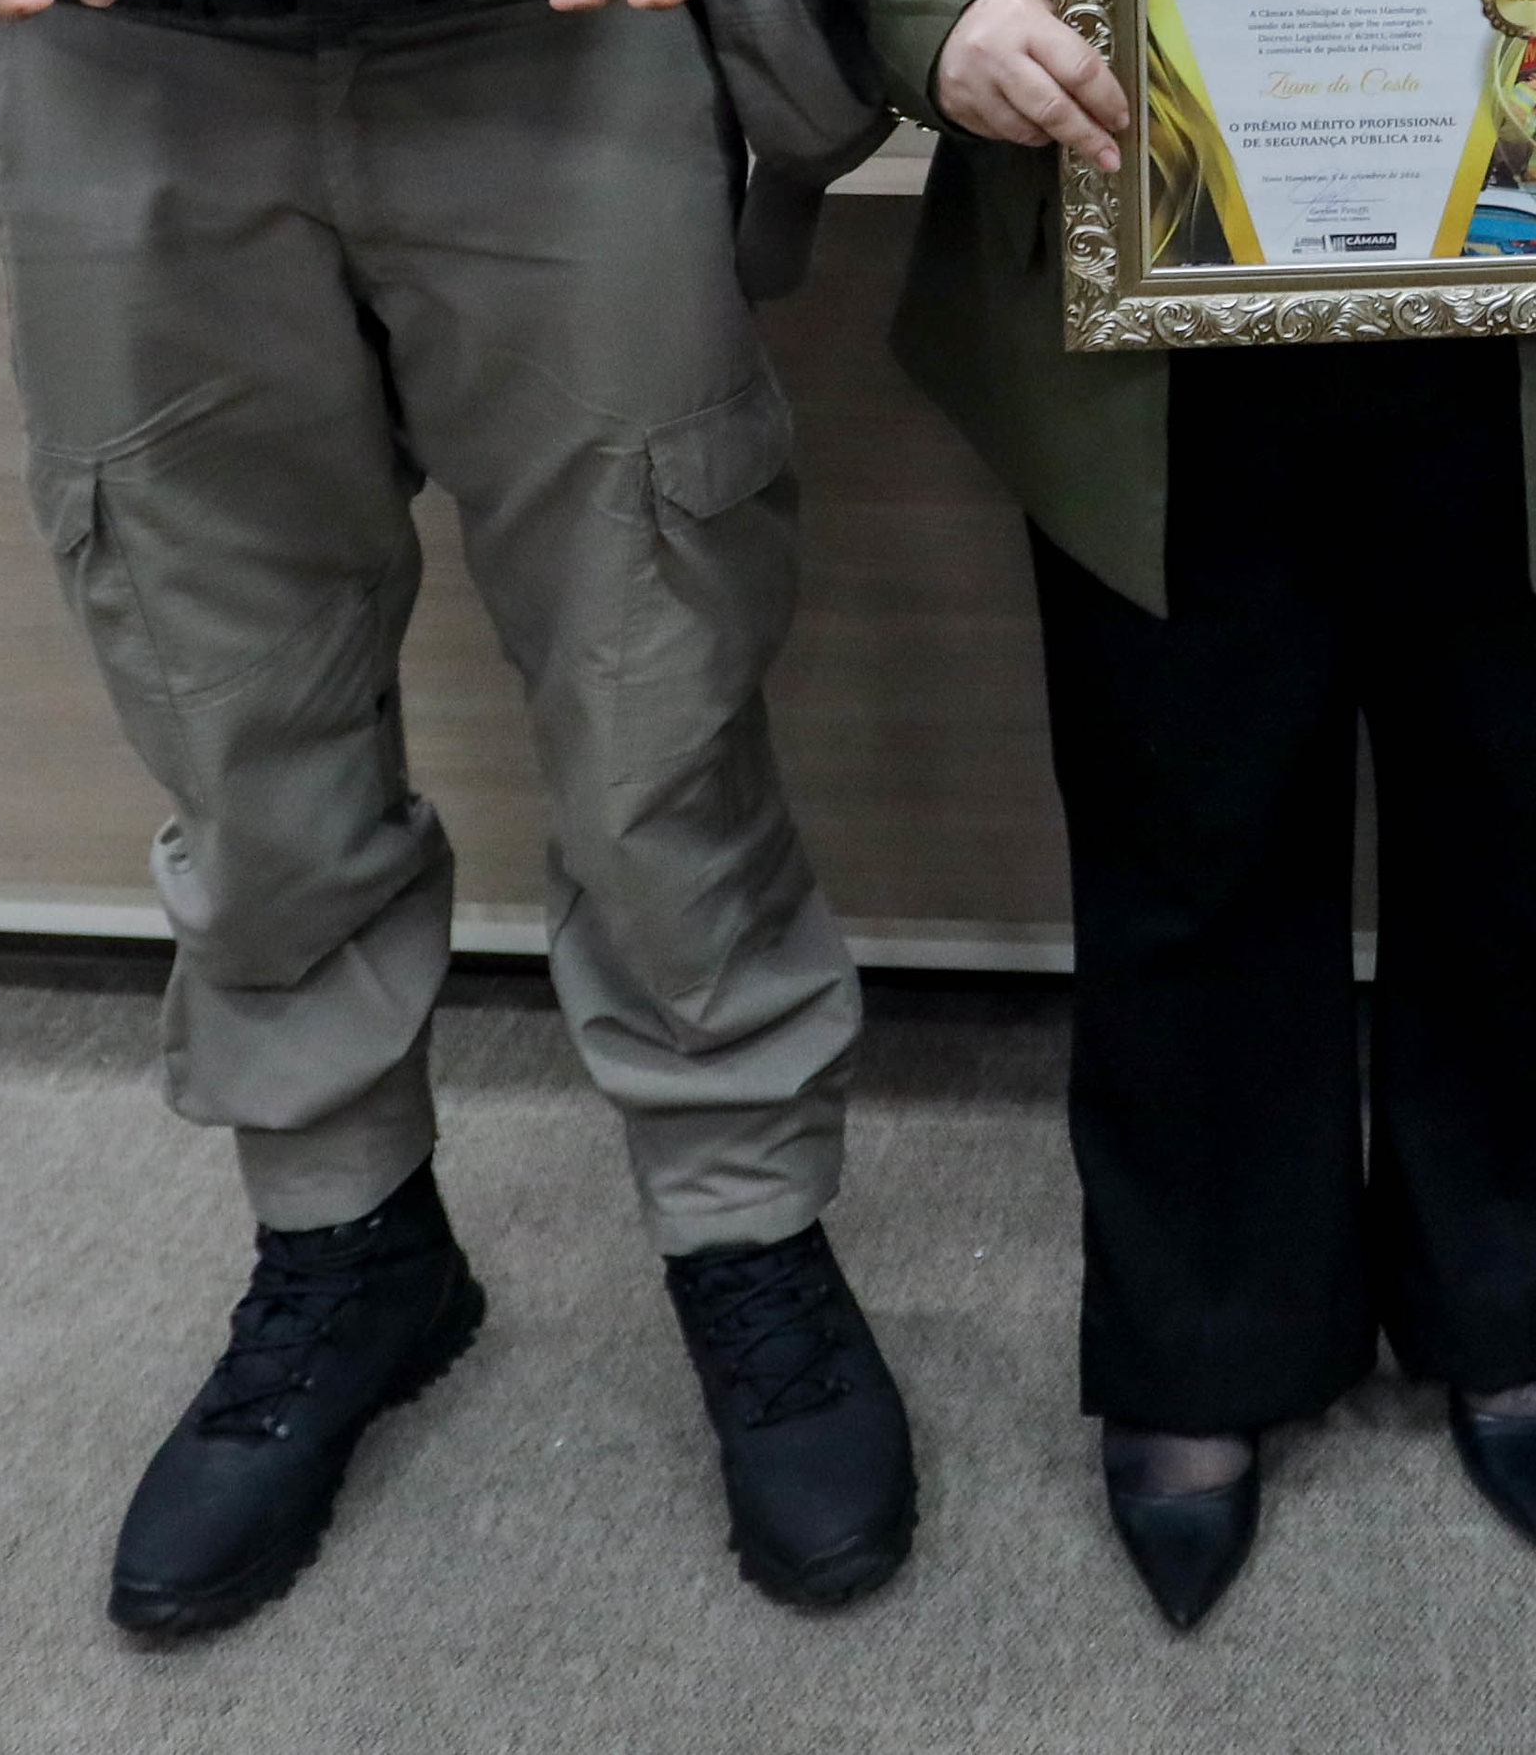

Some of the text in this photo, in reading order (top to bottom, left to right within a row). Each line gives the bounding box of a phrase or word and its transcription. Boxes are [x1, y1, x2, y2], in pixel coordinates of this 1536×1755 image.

[1230, 117, 1456, 132] O PRÊMIO MÉRITO PROFISSIONAL
[1243, 133, 1442, 148] DE SEGURANÇA PÚBLICA 2024
[1346, 236, 1395, 245] CÂMARA
